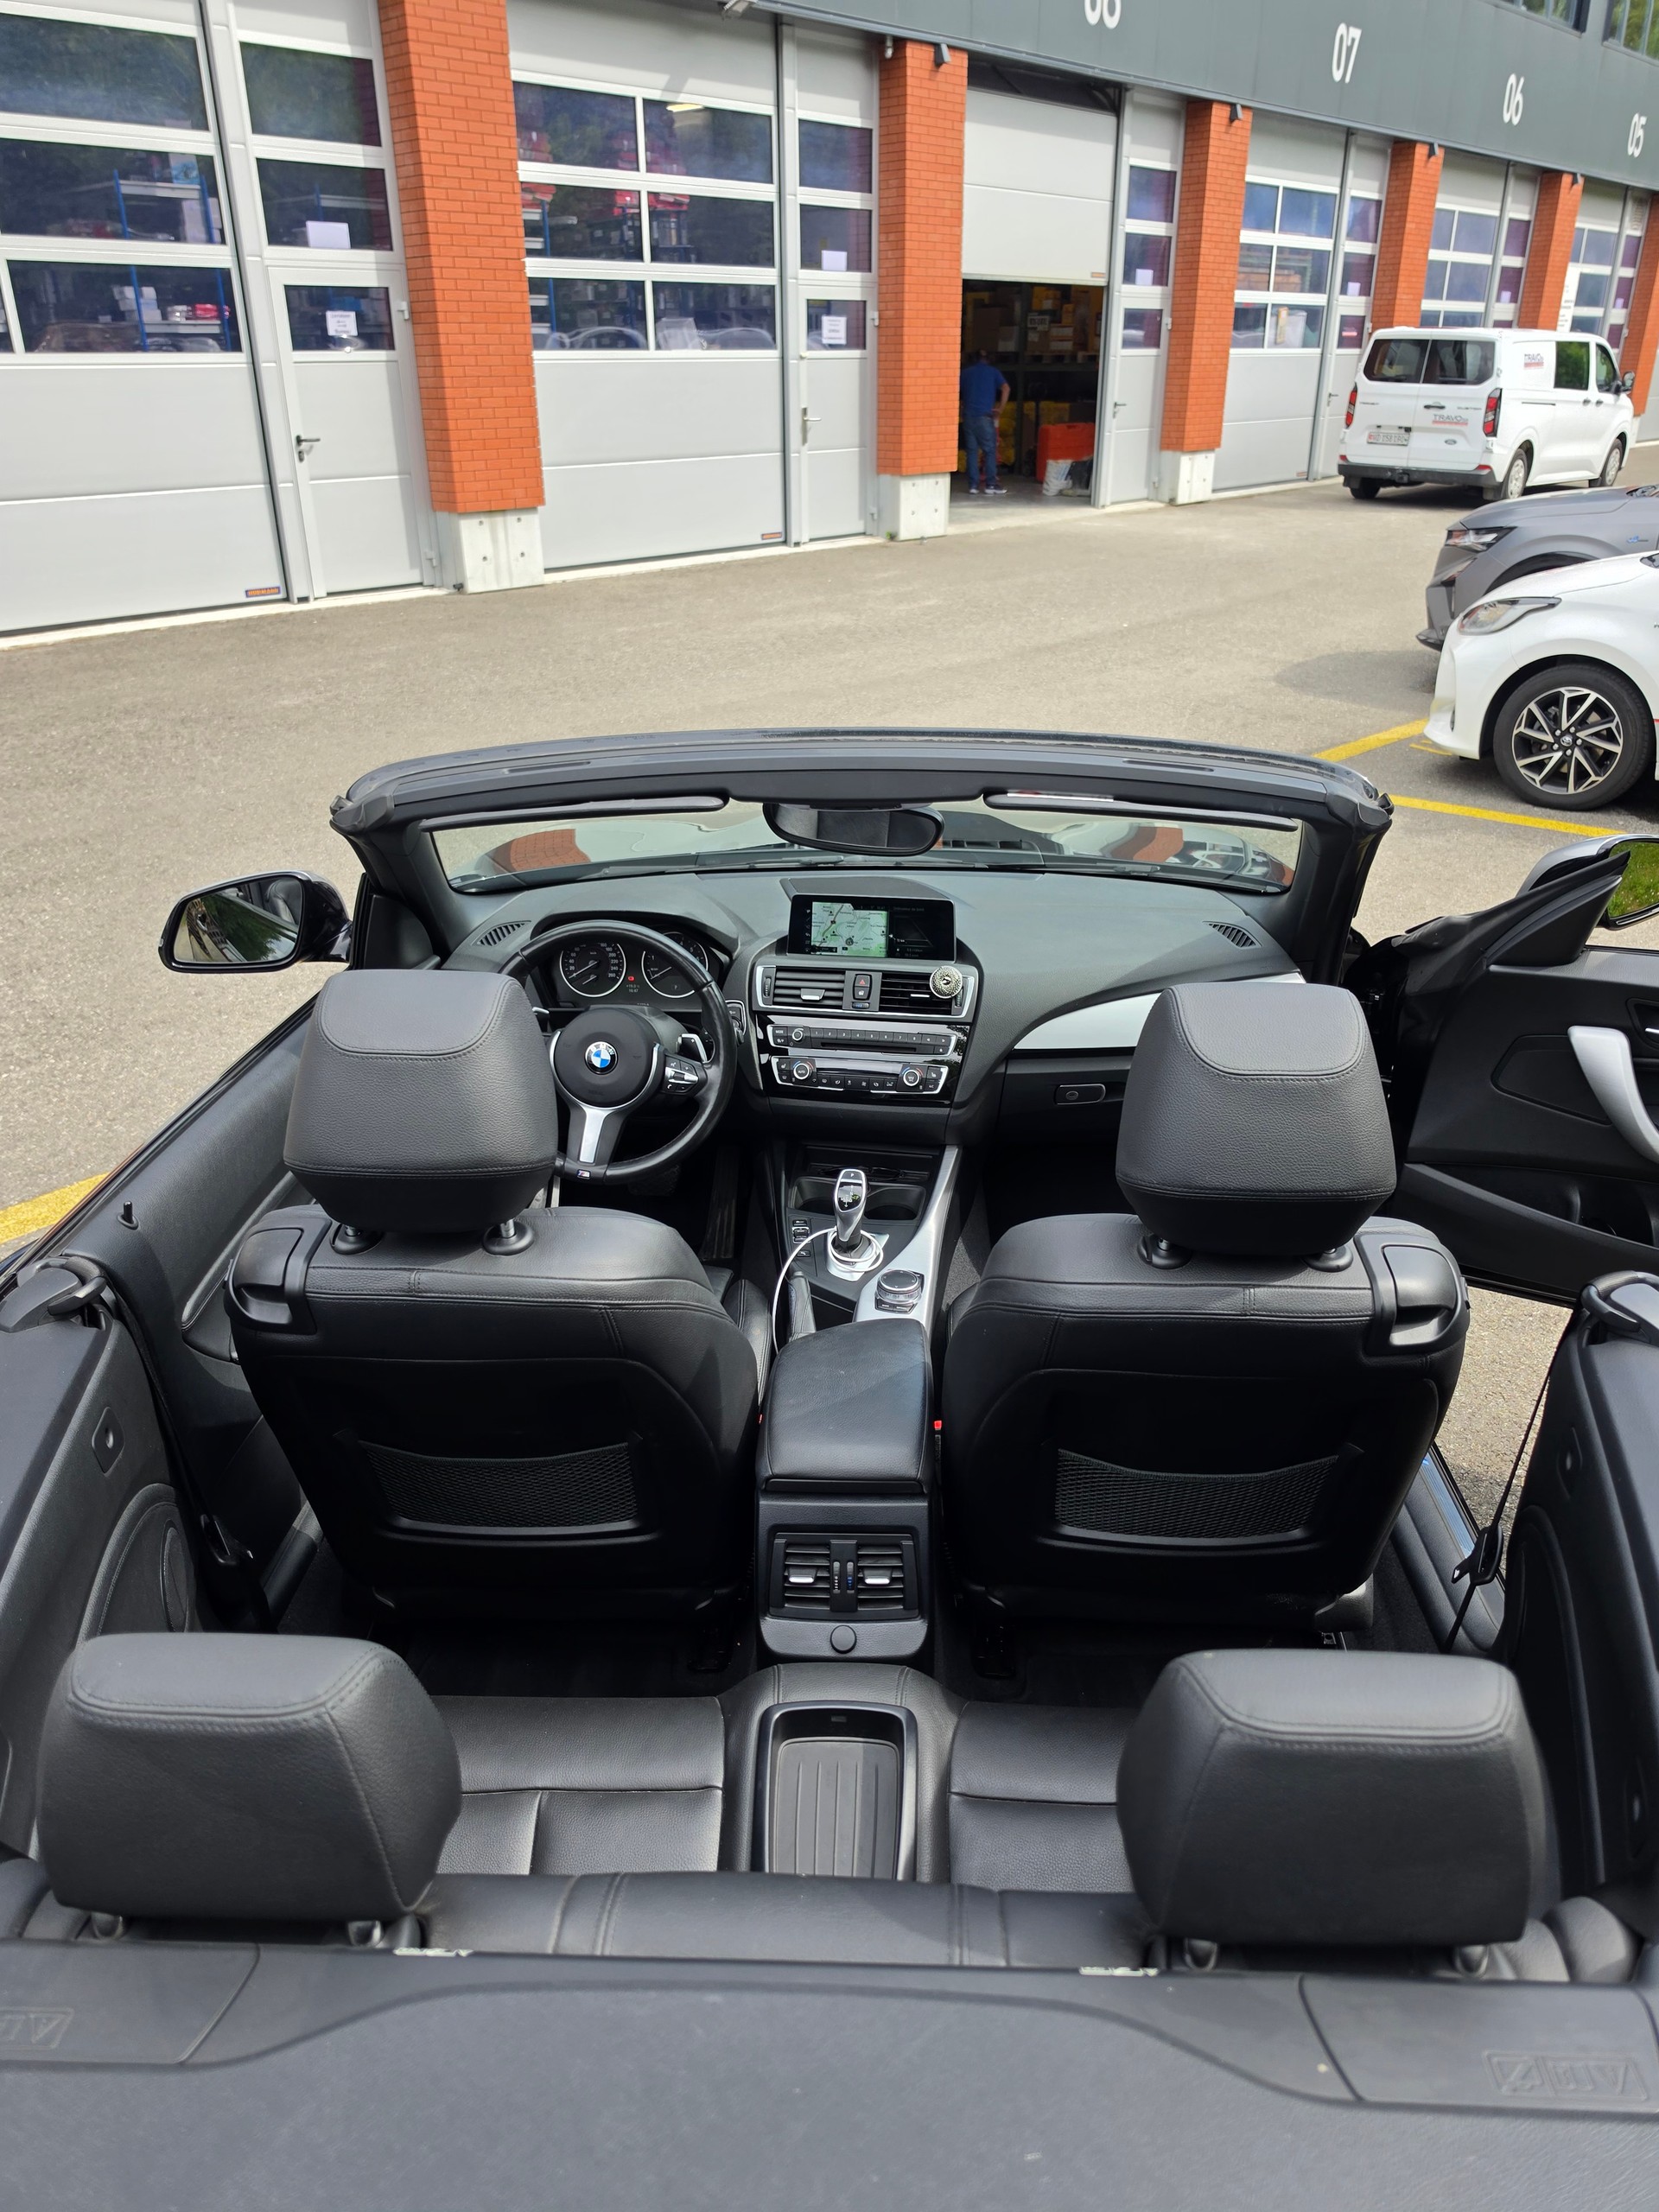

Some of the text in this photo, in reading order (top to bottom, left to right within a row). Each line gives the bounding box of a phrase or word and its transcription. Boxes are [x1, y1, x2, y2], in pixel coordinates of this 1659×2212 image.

[1332, 22, 1363, 84] 07
[1503, 73, 1525, 126] 06
[1627, 112, 1648, 158] 05
